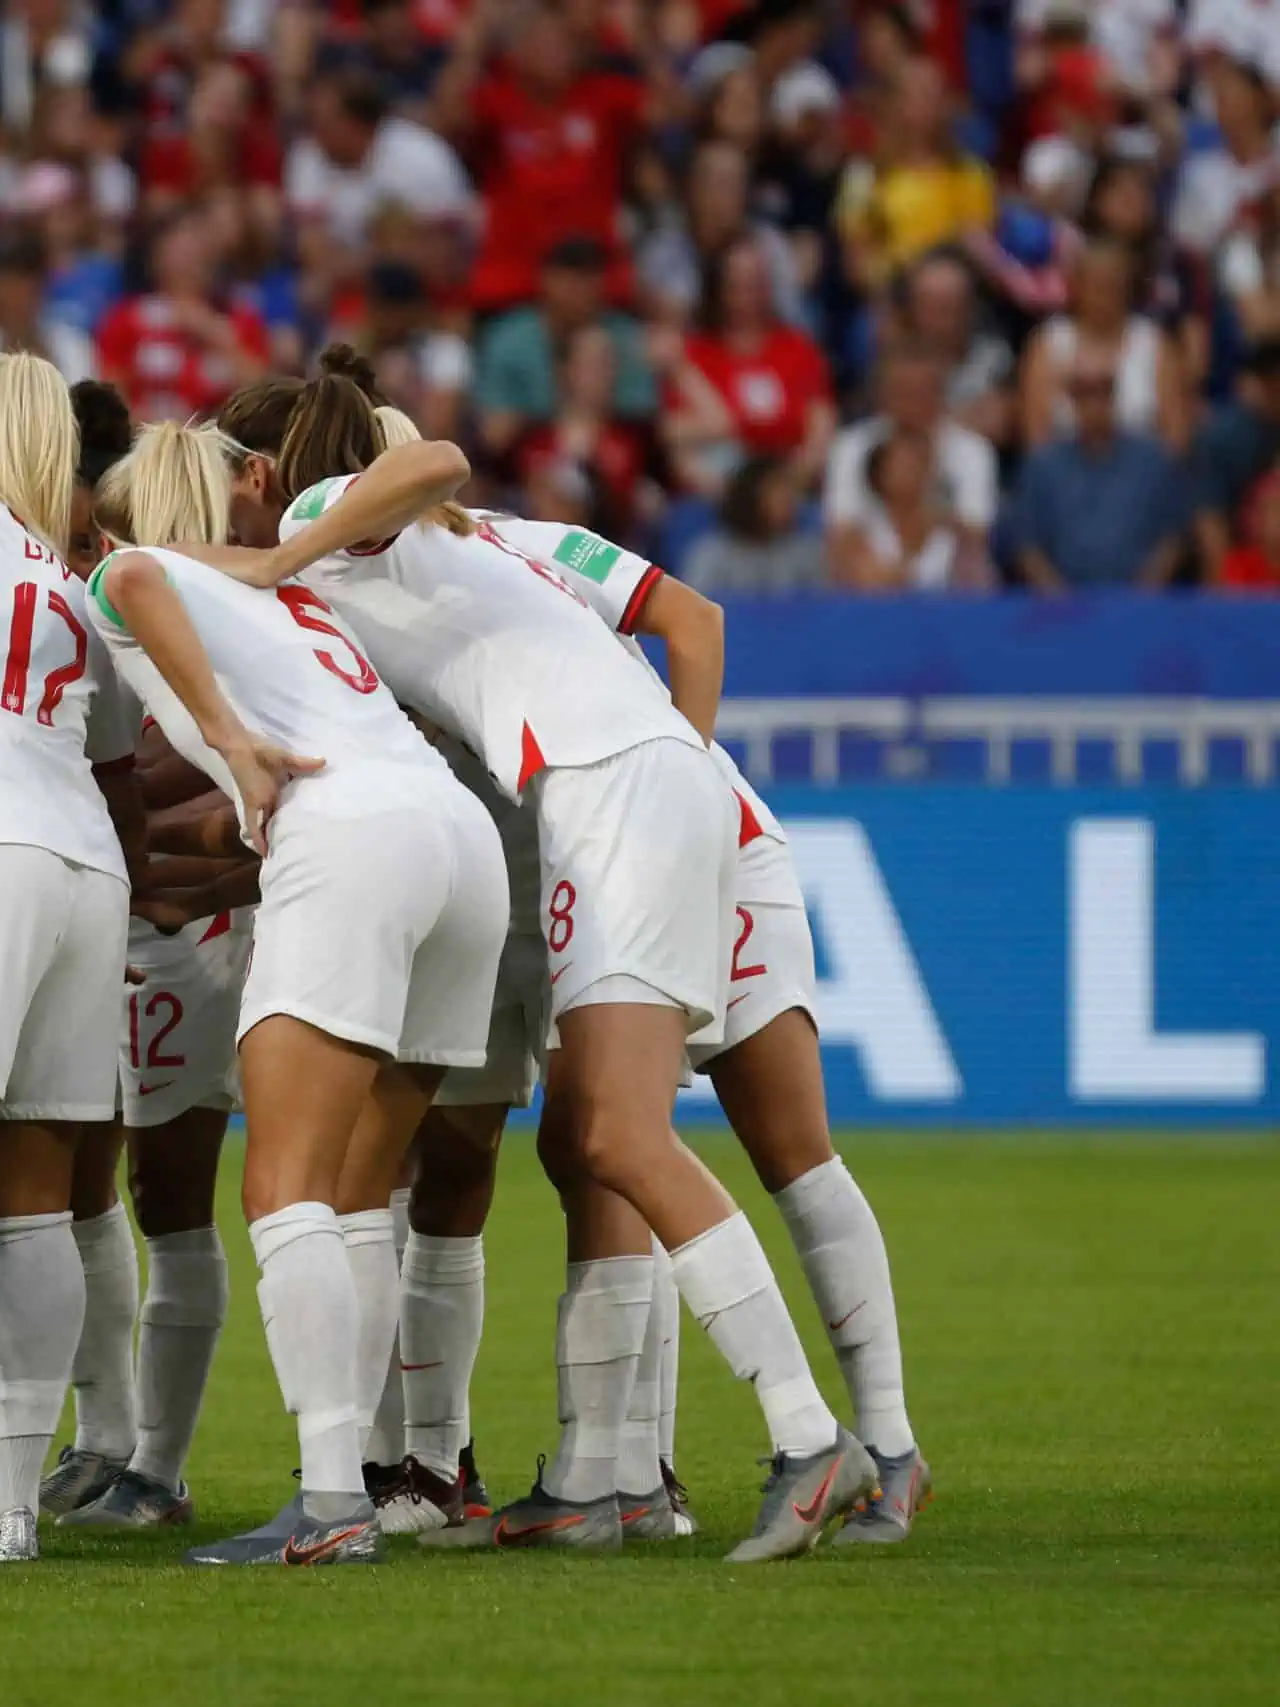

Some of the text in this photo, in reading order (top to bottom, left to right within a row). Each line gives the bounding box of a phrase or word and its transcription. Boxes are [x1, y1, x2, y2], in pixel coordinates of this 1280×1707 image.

[0, 581, 88, 728] 17
[276, 584, 380, 694] 5
[548, 879, 577, 953] 8
[730, 905, 769, 983] 2
[128, 990, 186, 1070] 12
